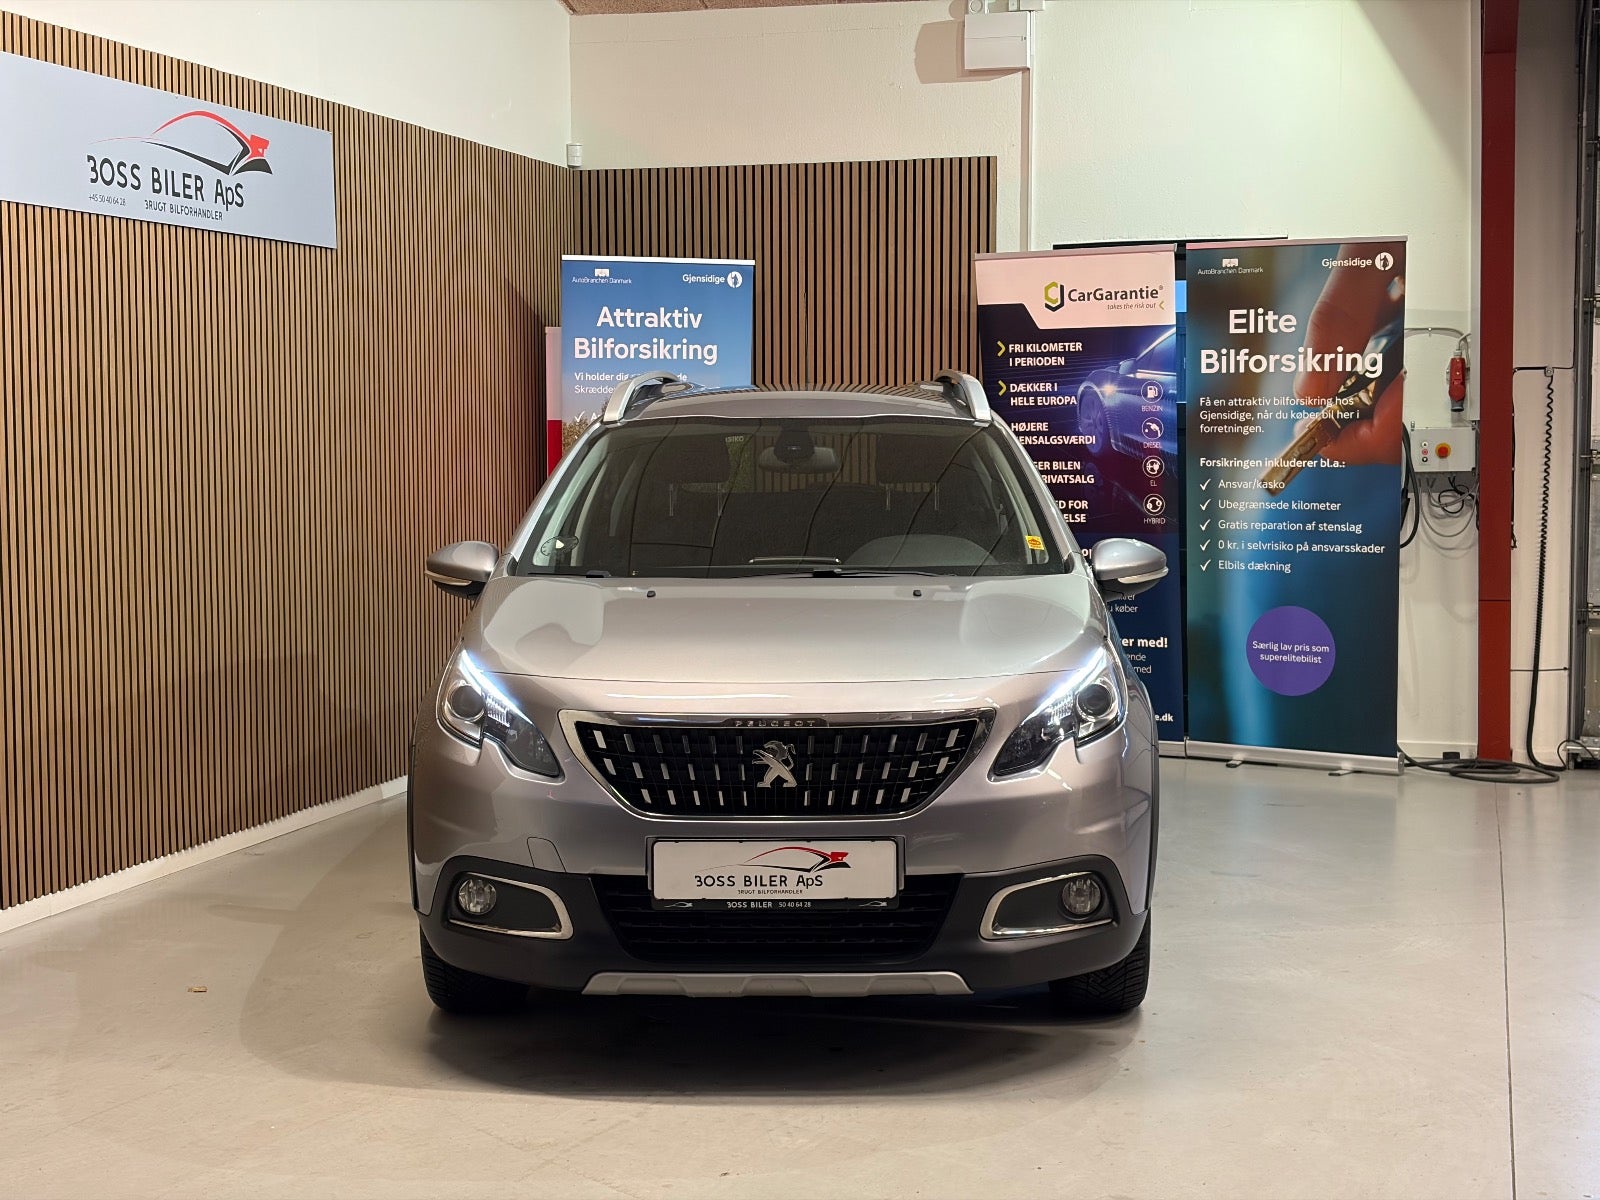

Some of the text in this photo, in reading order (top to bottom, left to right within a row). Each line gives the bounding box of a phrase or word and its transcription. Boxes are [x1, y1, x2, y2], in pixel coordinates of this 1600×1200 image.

[151, 167, 205, 202] BILER
[214, 178, 244, 212] ApS
[169, 204, 223, 221] BILFORHANDLER
[1321, 258, 1372, 269] Gjensidige
[1197, 267, 1237, 275] AutoBranchen
[682, 273, 726, 284] Gjensidige
[596, 306, 703, 329] Attraktiv
[1229, 307, 1297, 334] Elite
[574, 337, 718, 366] Bilforsikring
[1009, 342, 1082, 353] FRI KILOMETER
[1009, 356, 1065, 367] I PERIODEN
[1200, 345, 1383, 379] Bilforsikring
[574, 372, 585, 381] Vi
[586, 372, 613, 381] holder
[1010, 383, 1058, 393] DÆKKER I
[1010, 396, 1077, 406] HELE EUROPA
[1200, 396, 1354, 408] Få en attraktiv bilforsikring hos
[1200, 410, 1360, 422] Gjensidige, når du køber bil her i
[1011, 422, 1049, 432] HØJERE
[1200, 423, 1264, 435] forretningen.
[1017, 435, 1096, 445] ENSALGSVÆRDI
[1143, 441, 1163, 449] DIESEL
[1052, 461, 1081, 470] BILEN
[1200, 457, 1346, 469] Forsikringen inkluderer bl.a.:
[1042, 474, 1095, 484] RIVATSALG
[1218, 479, 1286, 490] Ansvar/kasko
[1068, 500, 1088, 510] FOR
[1218, 500, 1342, 512] Ubegrænsede kilometer
[1143, 517, 1166, 525] HYBRID
[1218, 519, 1363, 534] Gratis reparation af stenslag
[1218, 540, 1386, 554] 0 kr. i selvrisiko på ansvarsskader
[1218, 560, 1292, 573] Elbils dækning
[1115, 604, 1138, 613] køber
[1137, 636, 1168, 649] med!
[1252, 640, 1329, 653] Særlig lav pris som
[1259, 653, 1322, 664] superelitebilist
[743, 875, 788, 887] BILER
[795, 874, 823, 889] ApS
